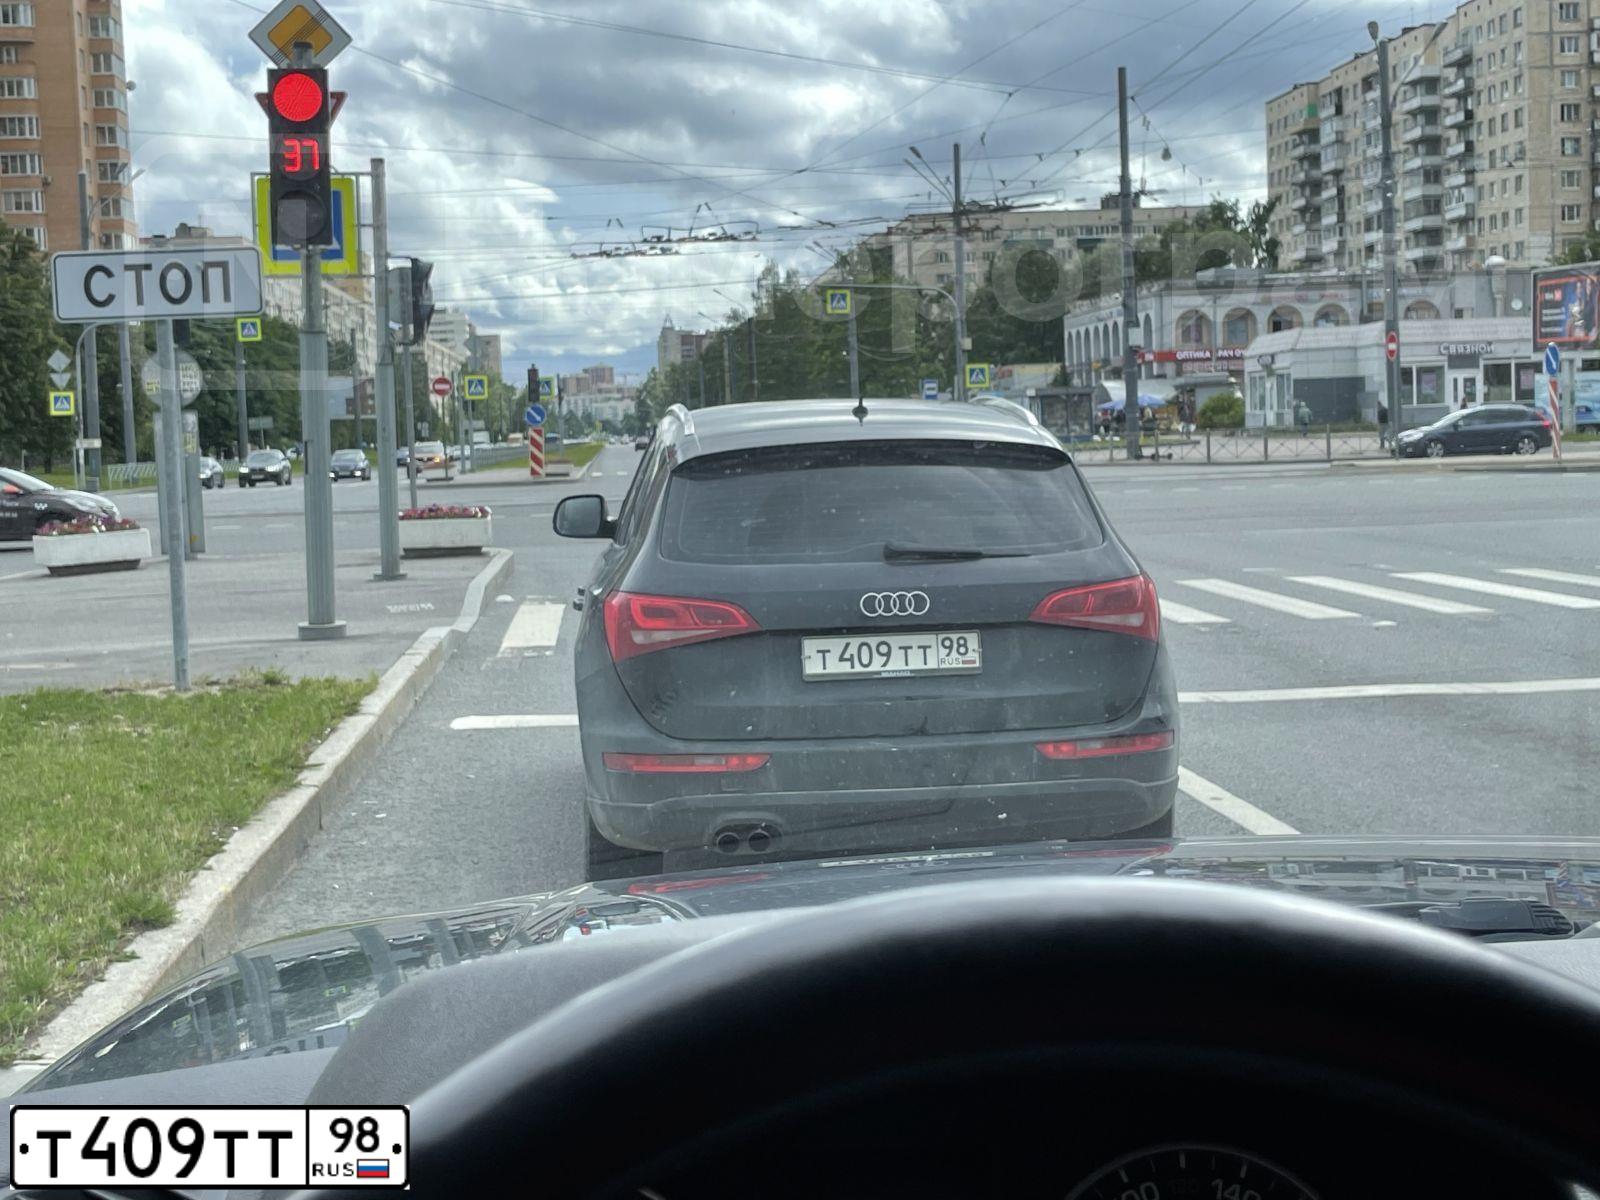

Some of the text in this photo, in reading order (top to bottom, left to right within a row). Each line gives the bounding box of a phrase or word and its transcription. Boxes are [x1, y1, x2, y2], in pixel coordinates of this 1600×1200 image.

[283, 138, 320, 173] 37
[83, 260, 232, 308] СТОП
[1176, 350, 1211, 360] ОПТИКА
[1440, 341, 1495, 355] Связной
[816, 635, 970, 671] Т409ТТ 98
[940, 657, 961, 667] RUS
